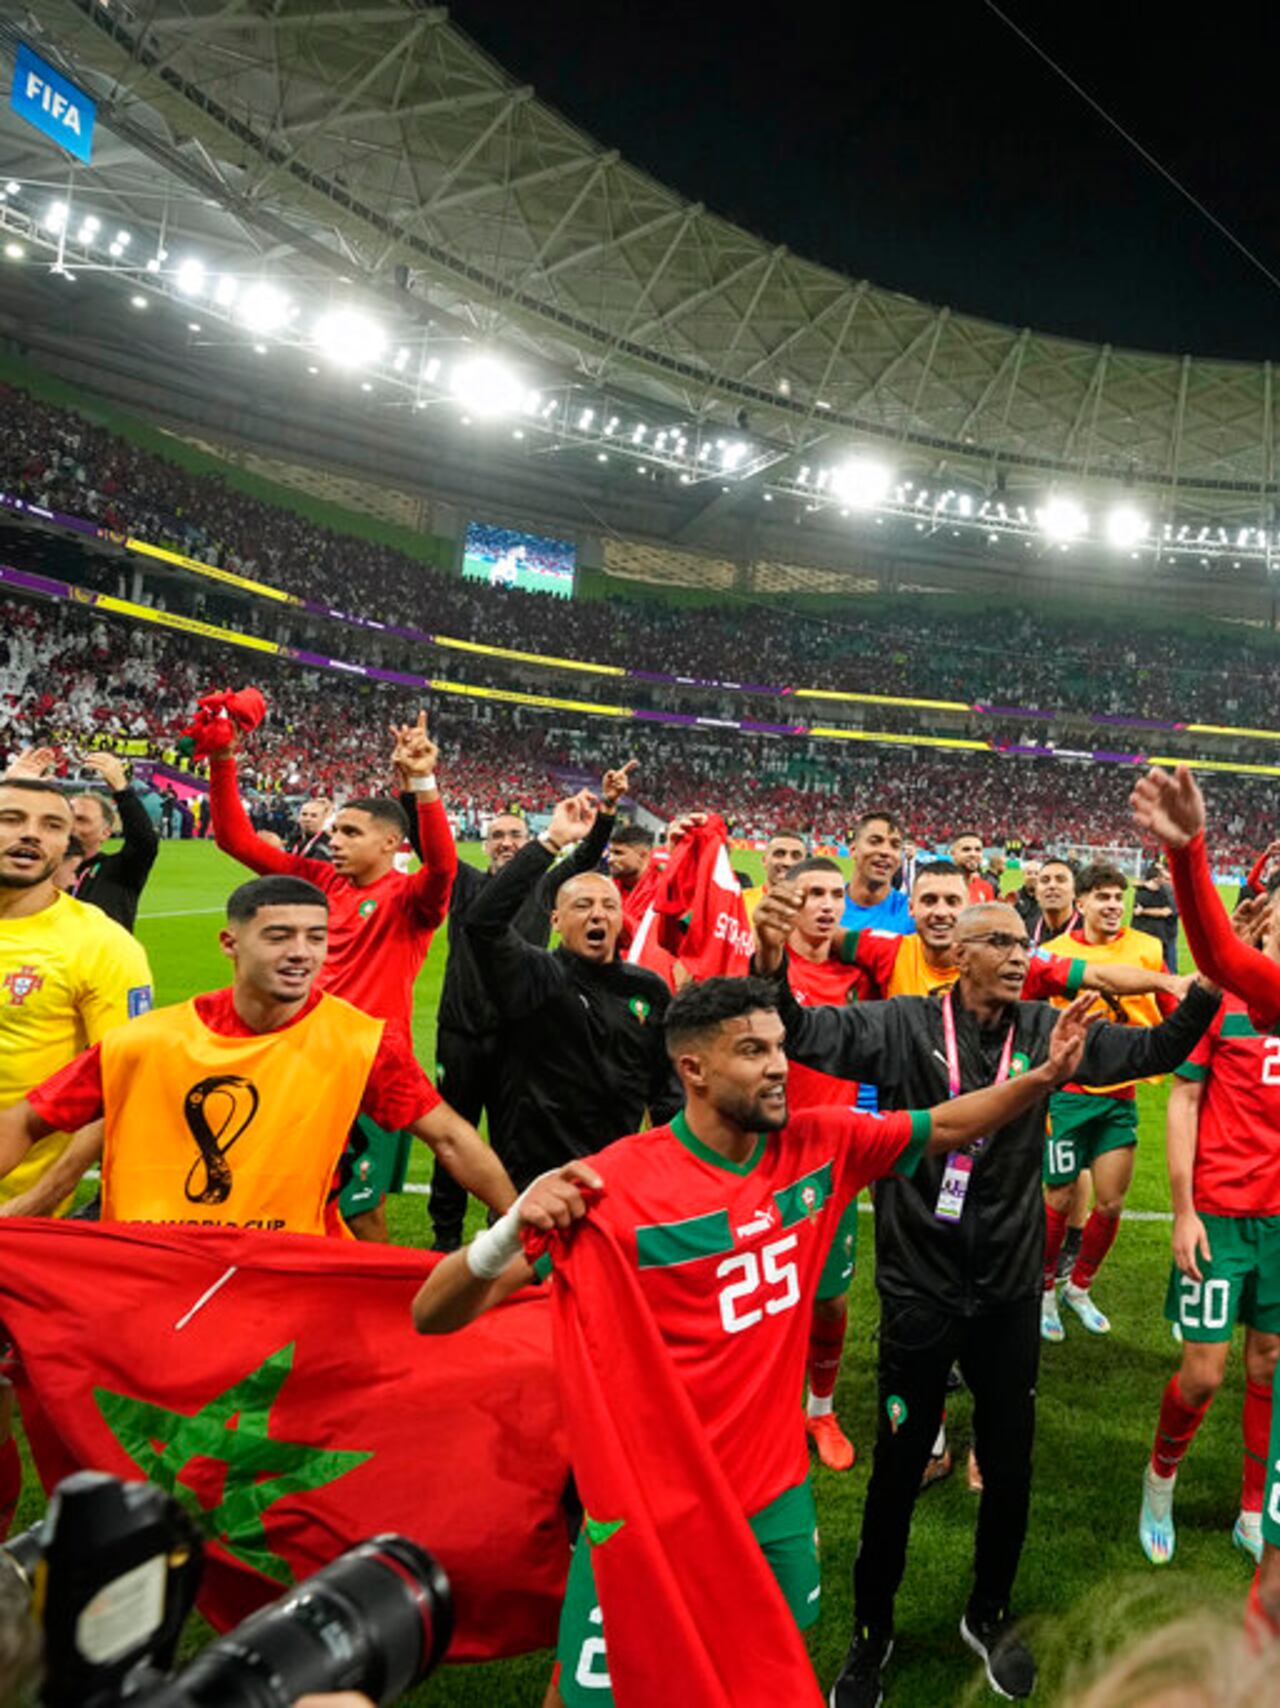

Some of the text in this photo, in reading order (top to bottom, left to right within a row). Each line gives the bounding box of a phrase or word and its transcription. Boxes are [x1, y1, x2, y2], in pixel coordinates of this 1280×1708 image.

[26, 71, 81, 136] FIFA
[1048, 1140, 1076, 1174] 16
[716, 1232, 801, 1334] 25
[1179, 1276, 1230, 1328] 20
